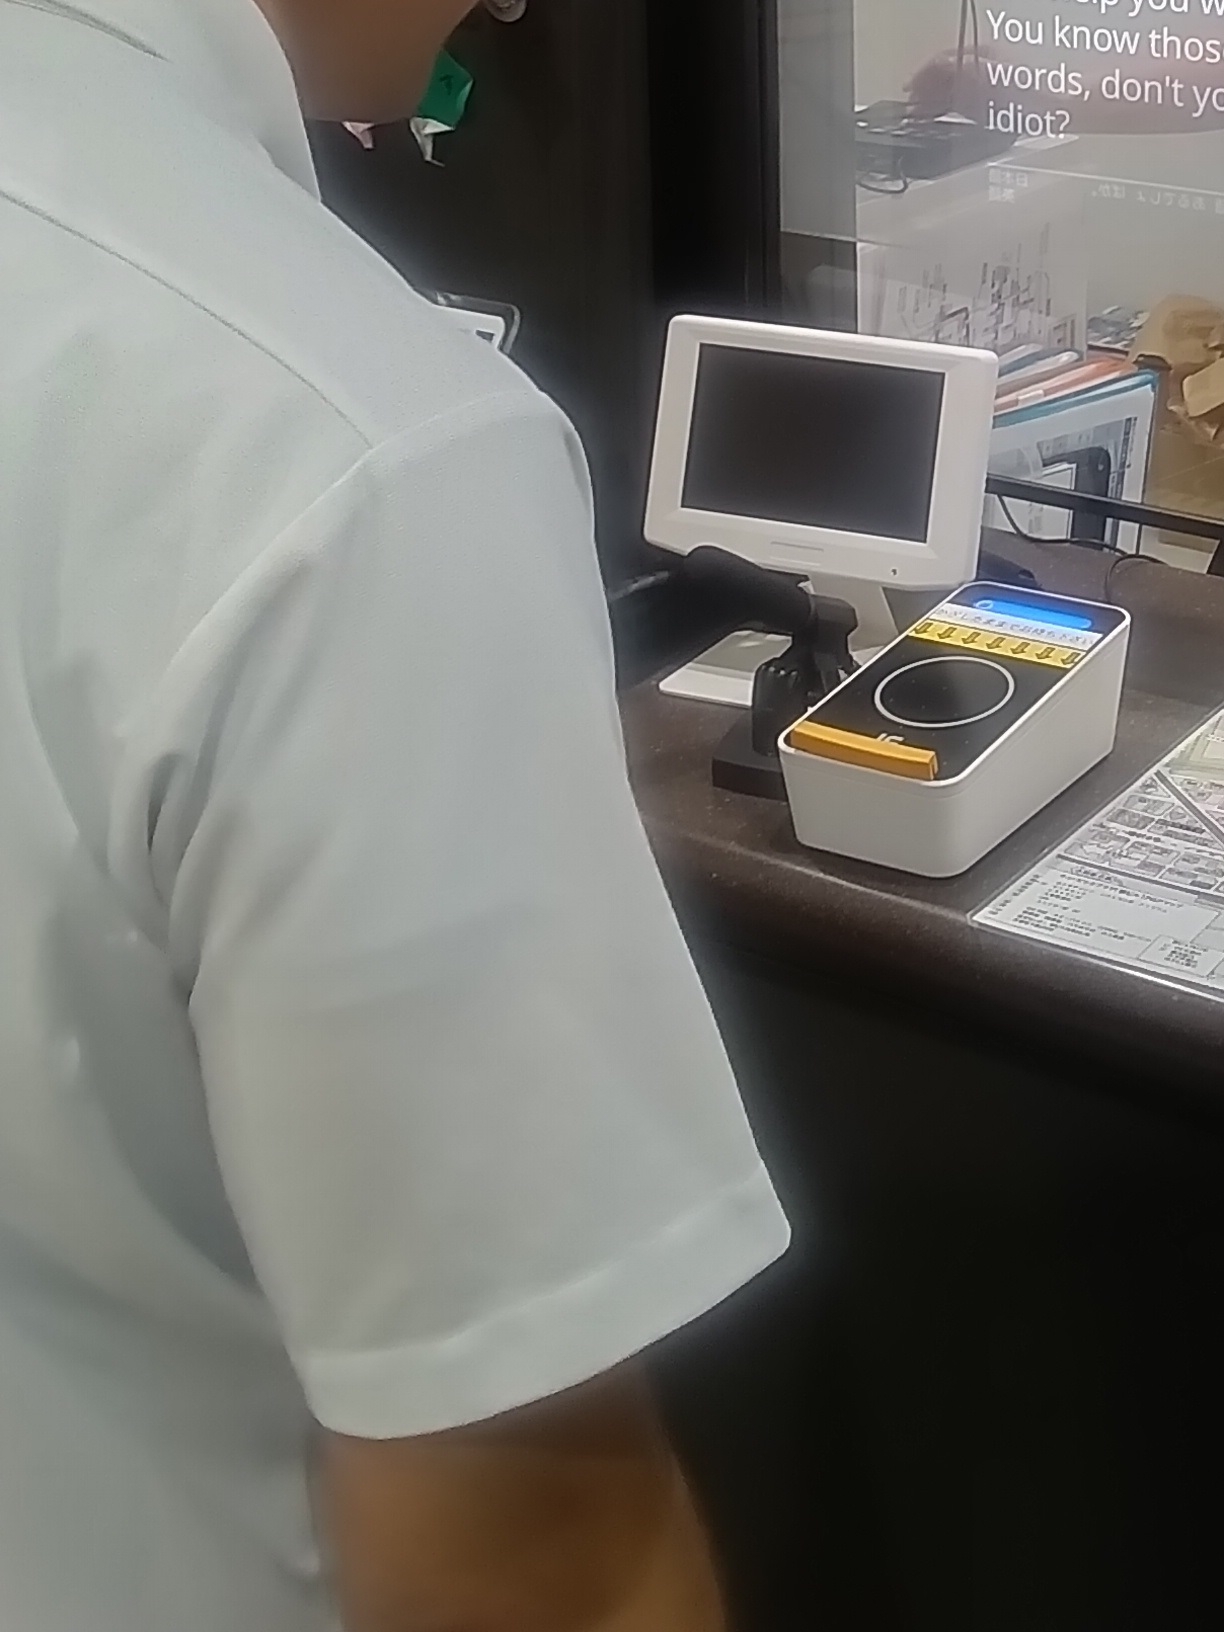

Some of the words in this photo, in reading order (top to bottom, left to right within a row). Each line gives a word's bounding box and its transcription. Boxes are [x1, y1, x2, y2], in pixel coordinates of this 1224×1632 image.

[986, 10, 1044, 44] You
[1054, 16, 1140, 55] know
[986, 60, 1091, 102] words,
[1101, 68, 1184, 108] don't
[986, 101, 1070, 139] idiot?
